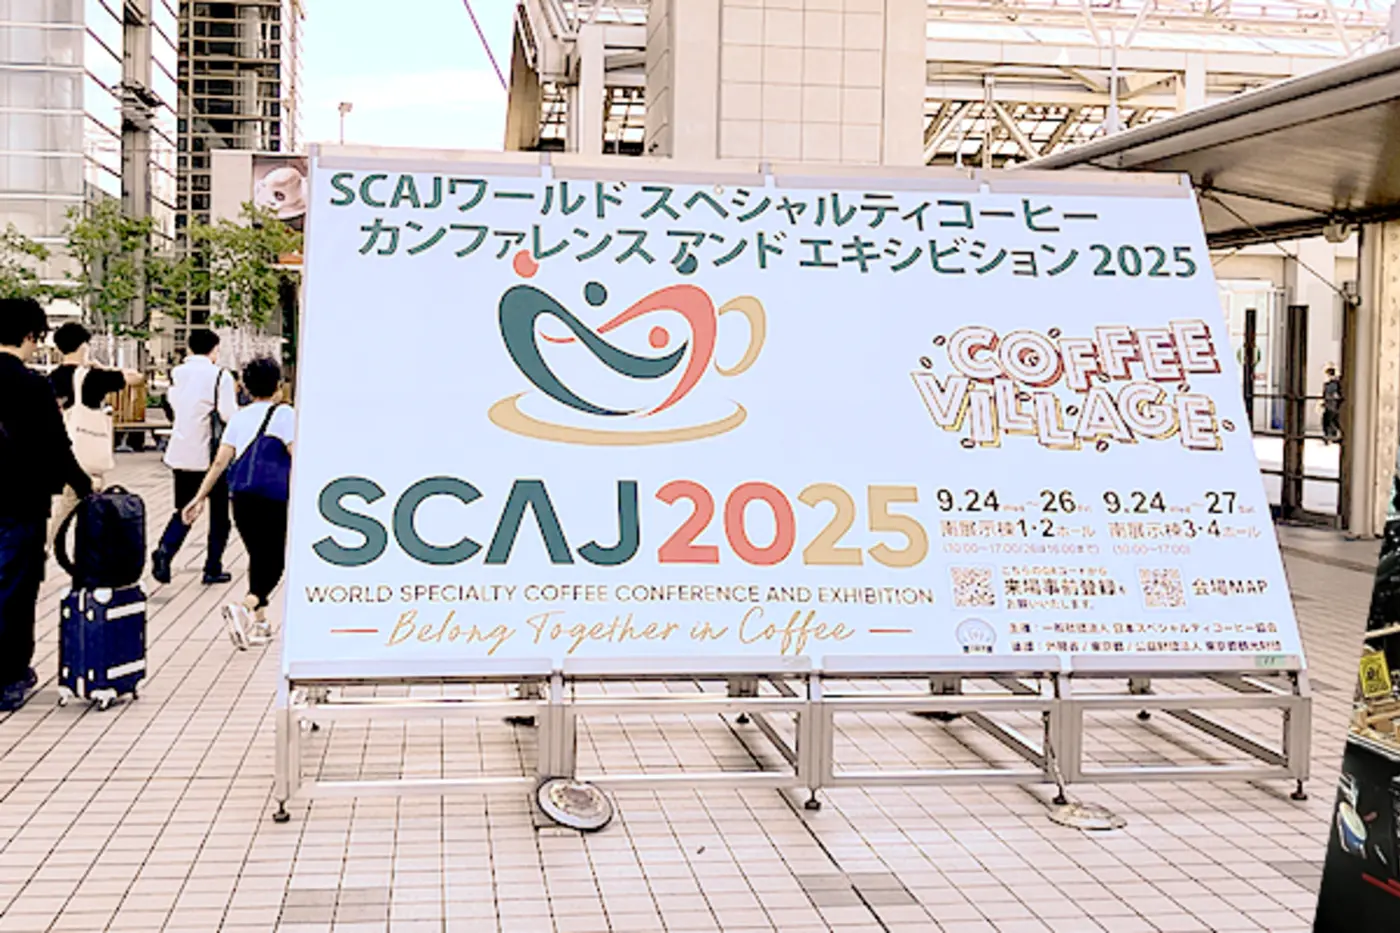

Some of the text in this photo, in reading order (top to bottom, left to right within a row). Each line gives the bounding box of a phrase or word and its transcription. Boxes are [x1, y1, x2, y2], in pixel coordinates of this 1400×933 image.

[330, 173, 1098, 232] SCAJワールド スペシャルティコーヒー
[359, 218, 1197, 279] カンファレンス アンド エキシビション 2025
[946, 319, 1221, 392] COFFEE
[911, 371, 1224, 452] VILLAGE
[305, 584, 935, 606] WORLD SPECIALTY COFFEE CONFERENCE AND EXHIBITION
[386, 606, 856, 656] Belong Together in Coffee
